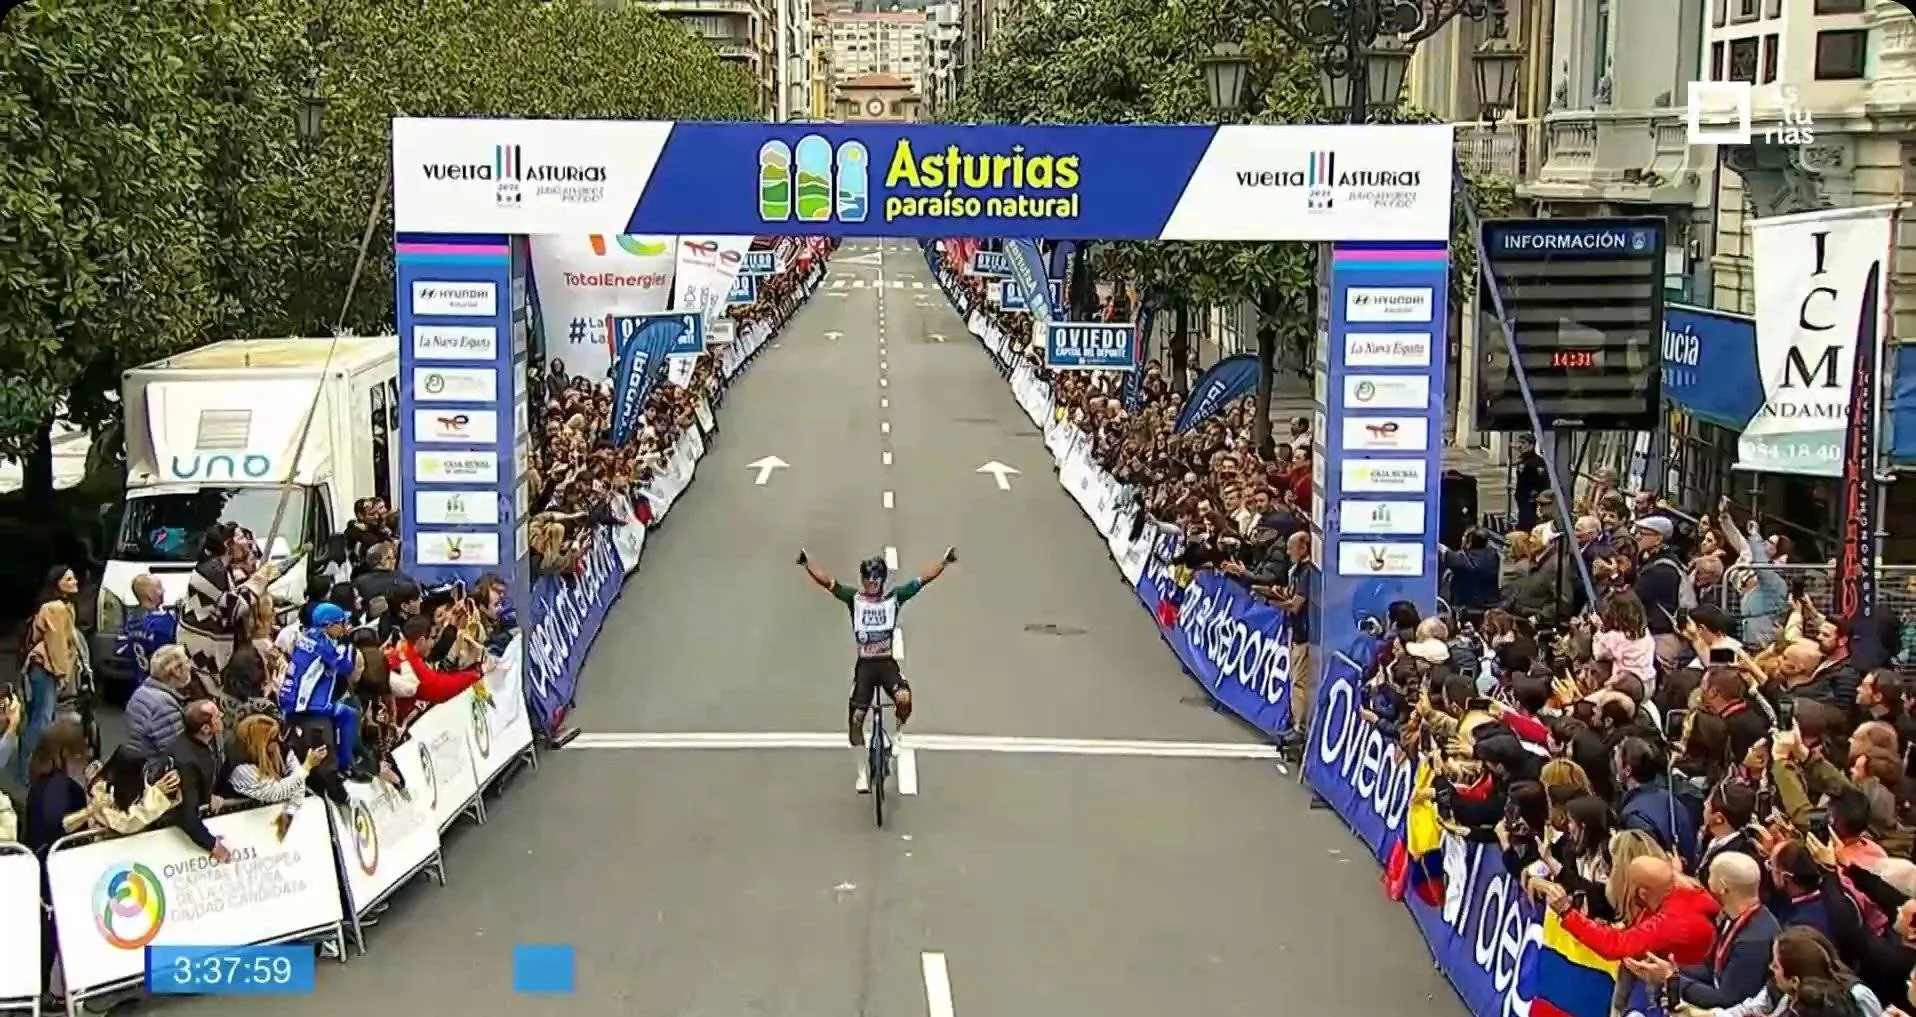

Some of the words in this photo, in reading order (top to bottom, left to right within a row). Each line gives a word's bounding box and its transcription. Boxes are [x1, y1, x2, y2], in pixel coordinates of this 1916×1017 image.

[885, 138, 1080, 189] Asturias
[885, 189, 981, 221] paraíso
[987, 193, 1079, 218] natural
[1504, 230, 1626, 249] INFORMACIÓN
[563, 272, 666, 289] TotalEnergies
[1055, 327, 1128, 349] OVIEDO
[1553, 351, 1592, 367] 14:31
[1816, 444, 1841, 462] 40
